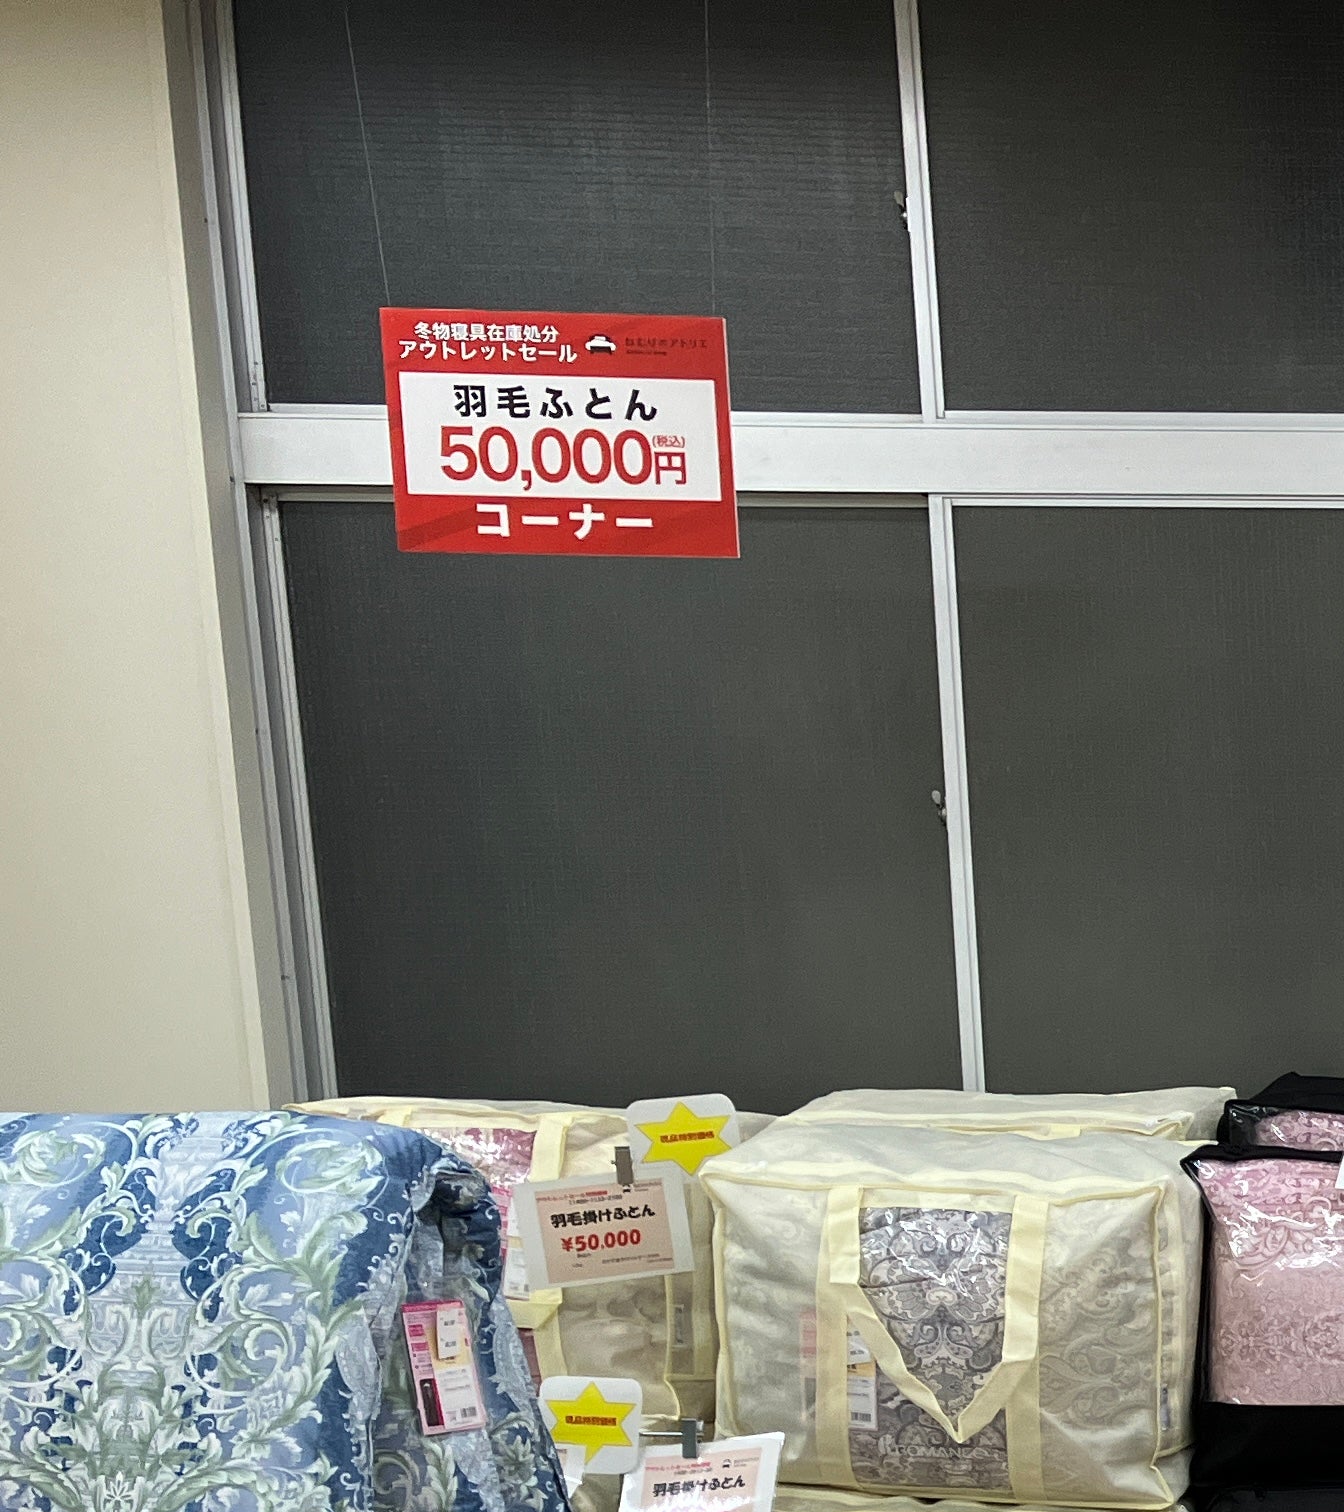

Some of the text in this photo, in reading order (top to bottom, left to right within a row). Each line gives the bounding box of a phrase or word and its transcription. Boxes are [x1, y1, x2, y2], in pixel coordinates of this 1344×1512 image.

[414, 322, 559, 342] 冬物寝具在庫処分
[399, 341, 577, 363] アウトレットセール
[453, 385, 657, 421] 羽毛ふとん
[475, 503, 653, 539] コーナー
[550, 1204, 655, 1229] 羽毛掛けふとん
